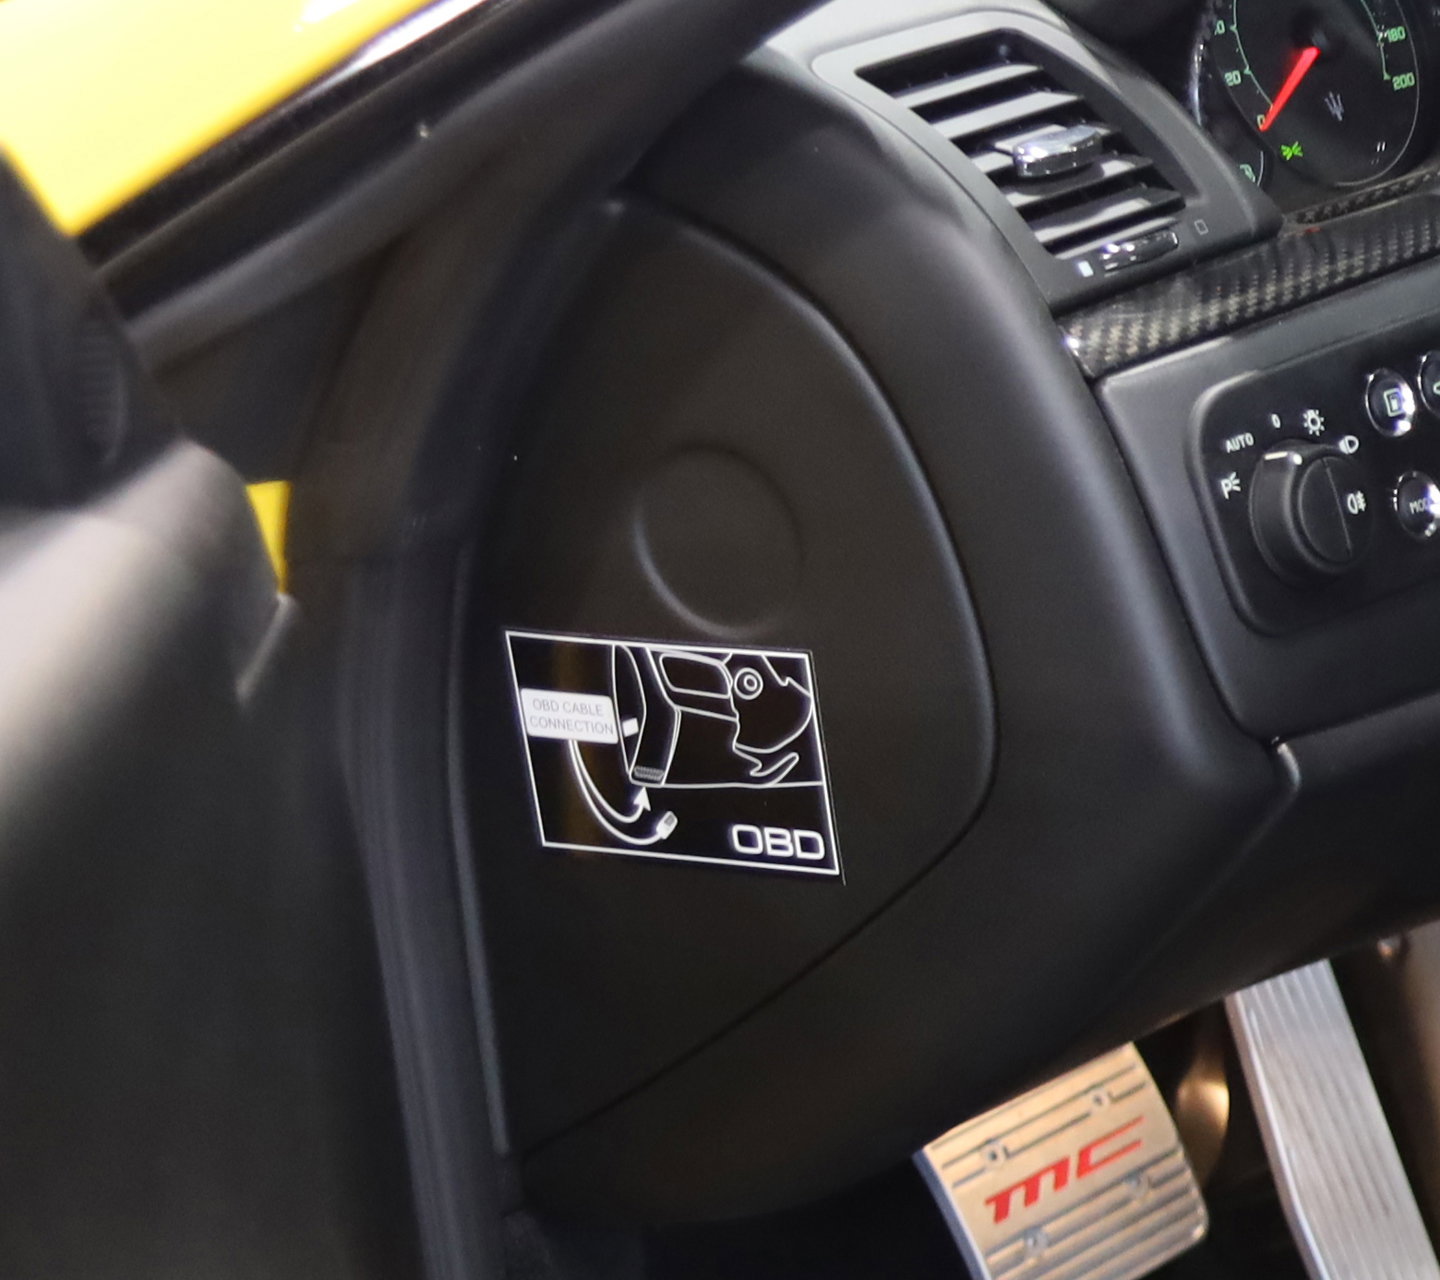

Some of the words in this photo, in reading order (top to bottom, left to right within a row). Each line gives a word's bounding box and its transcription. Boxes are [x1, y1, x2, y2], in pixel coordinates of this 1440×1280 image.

[1387, 26, 1406, 42] 180
[1224, 70, 1242, 86] 20
[1392, 72, 1416, 91] 200
[1225, 432, 1254, 453] AUTO
[532, 698, 560, 712] OBD
[562, 701, 604, 717] CABLE
[529, 715, 614, 735] CONNECTION
[731, 823, 826, 861] OBD
